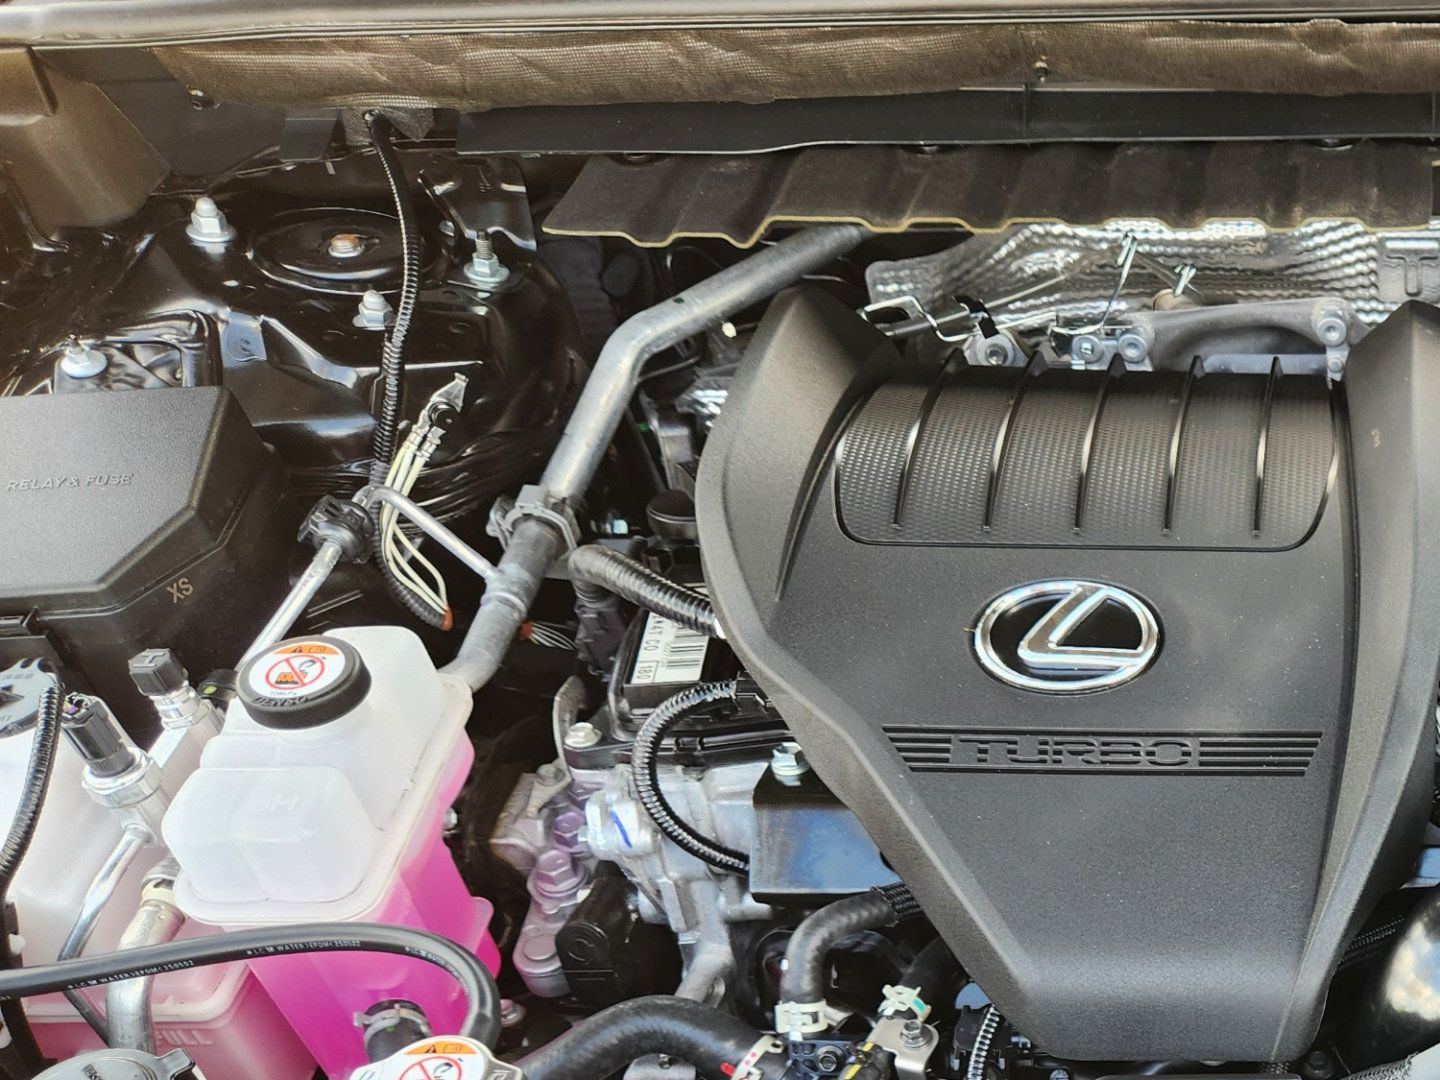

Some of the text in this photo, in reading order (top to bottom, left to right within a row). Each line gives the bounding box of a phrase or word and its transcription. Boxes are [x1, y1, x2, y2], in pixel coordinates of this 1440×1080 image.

[7, 476, 67, 491] RELAY
[86, 473, 134, 486] FUSE
[166, 577, 193, 603] XS
[959, 736, 1193, 767] TURBO
